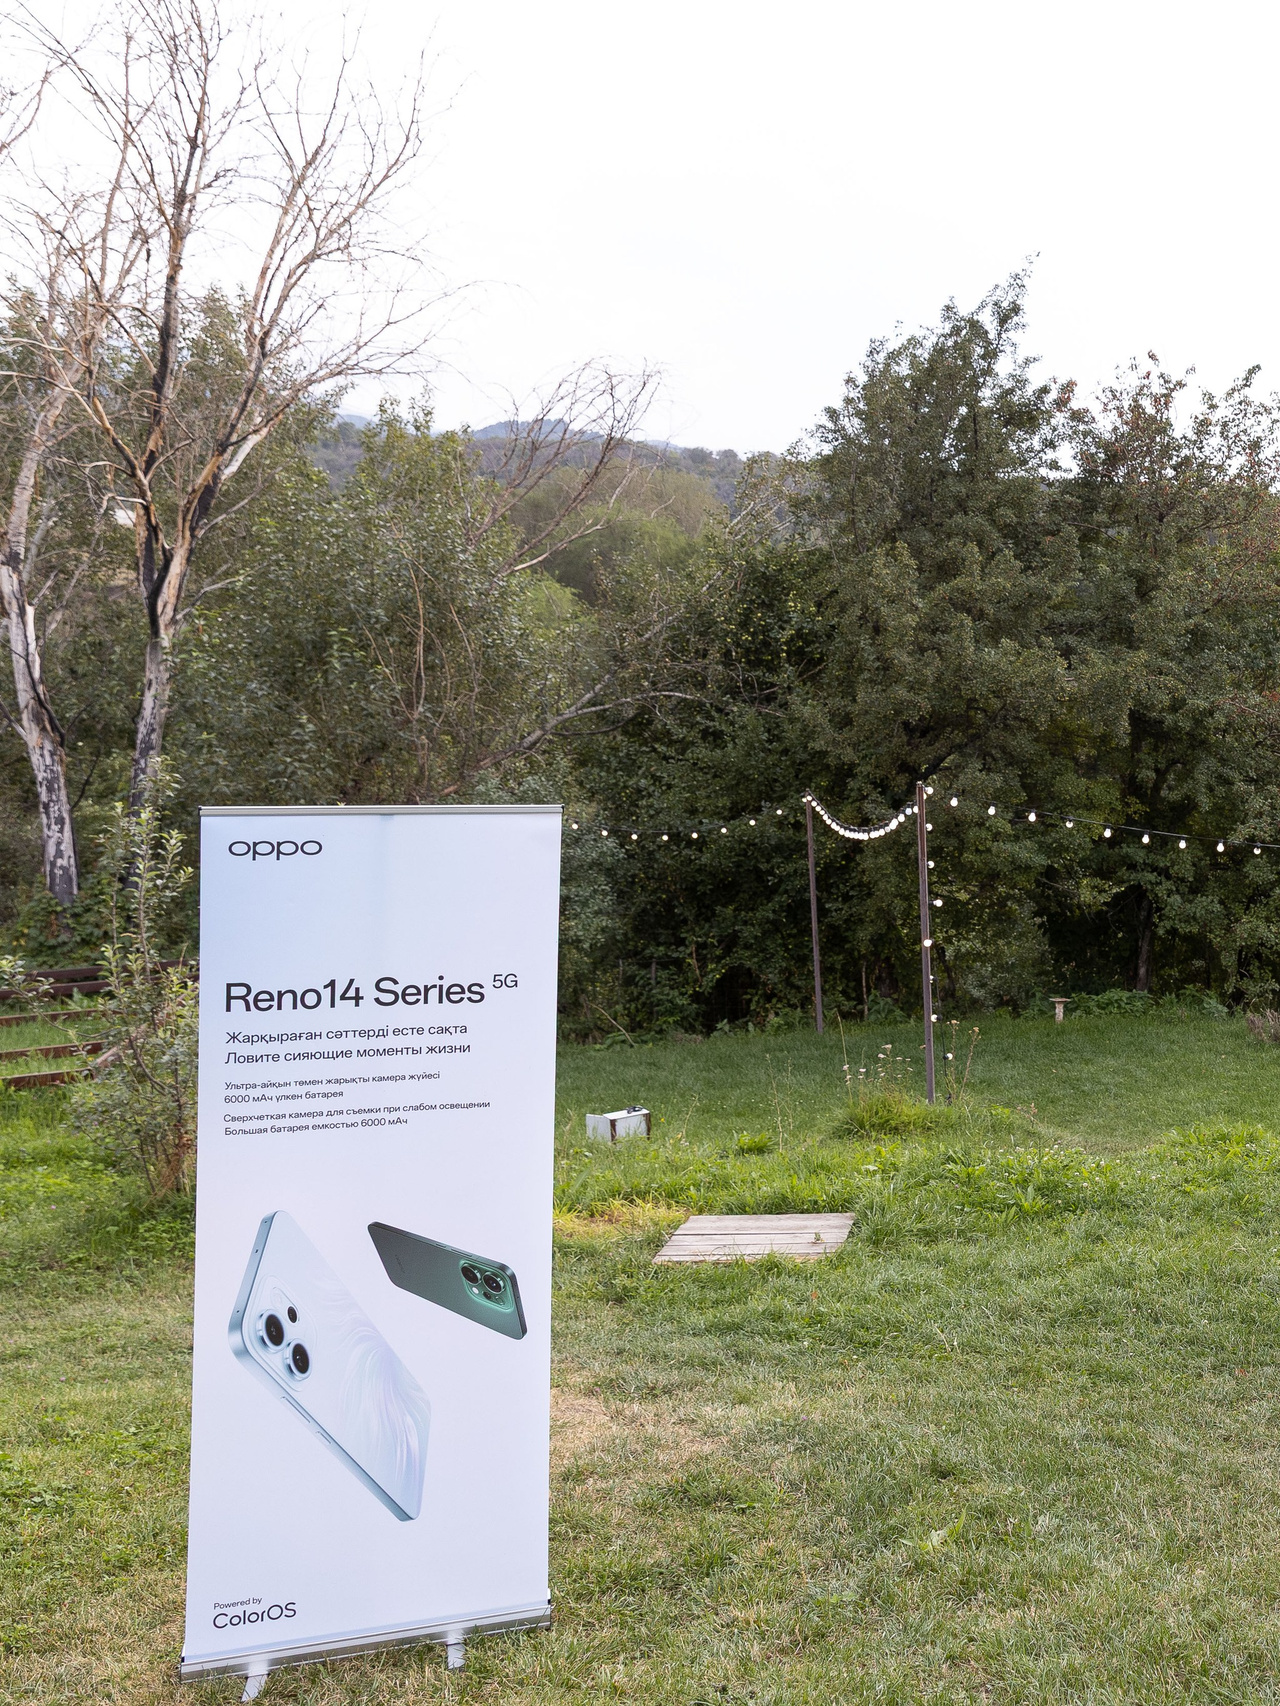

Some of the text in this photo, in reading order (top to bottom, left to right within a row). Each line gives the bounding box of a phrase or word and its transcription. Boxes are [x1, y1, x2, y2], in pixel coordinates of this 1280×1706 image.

[228, 839, 323, 862] oppo
[225, 973, 518, 1013] Reno14 Series 5G
[225, 1024, 468, 1046] Жарқыраған сәттерді есте сақта
[224, 1044, 471, 1065] Ловите сияющие моменты жизни
[224, 1070, 440, 1091] Ультра-айқын төмен жарықты камера жүйесі
[223, 1090, 344, 1104] 6000 мАч үлкен батарея
[223, 1101, 491, 1124] Сверхчеткая камера для съемки при слабом освещении
[224, 1116, 408, 1136] Большая батарея емкостью 6000 мАч
[213, 1597, 263, 1610] Powered by
[212, 1601, 297, 1629] ColorOS
